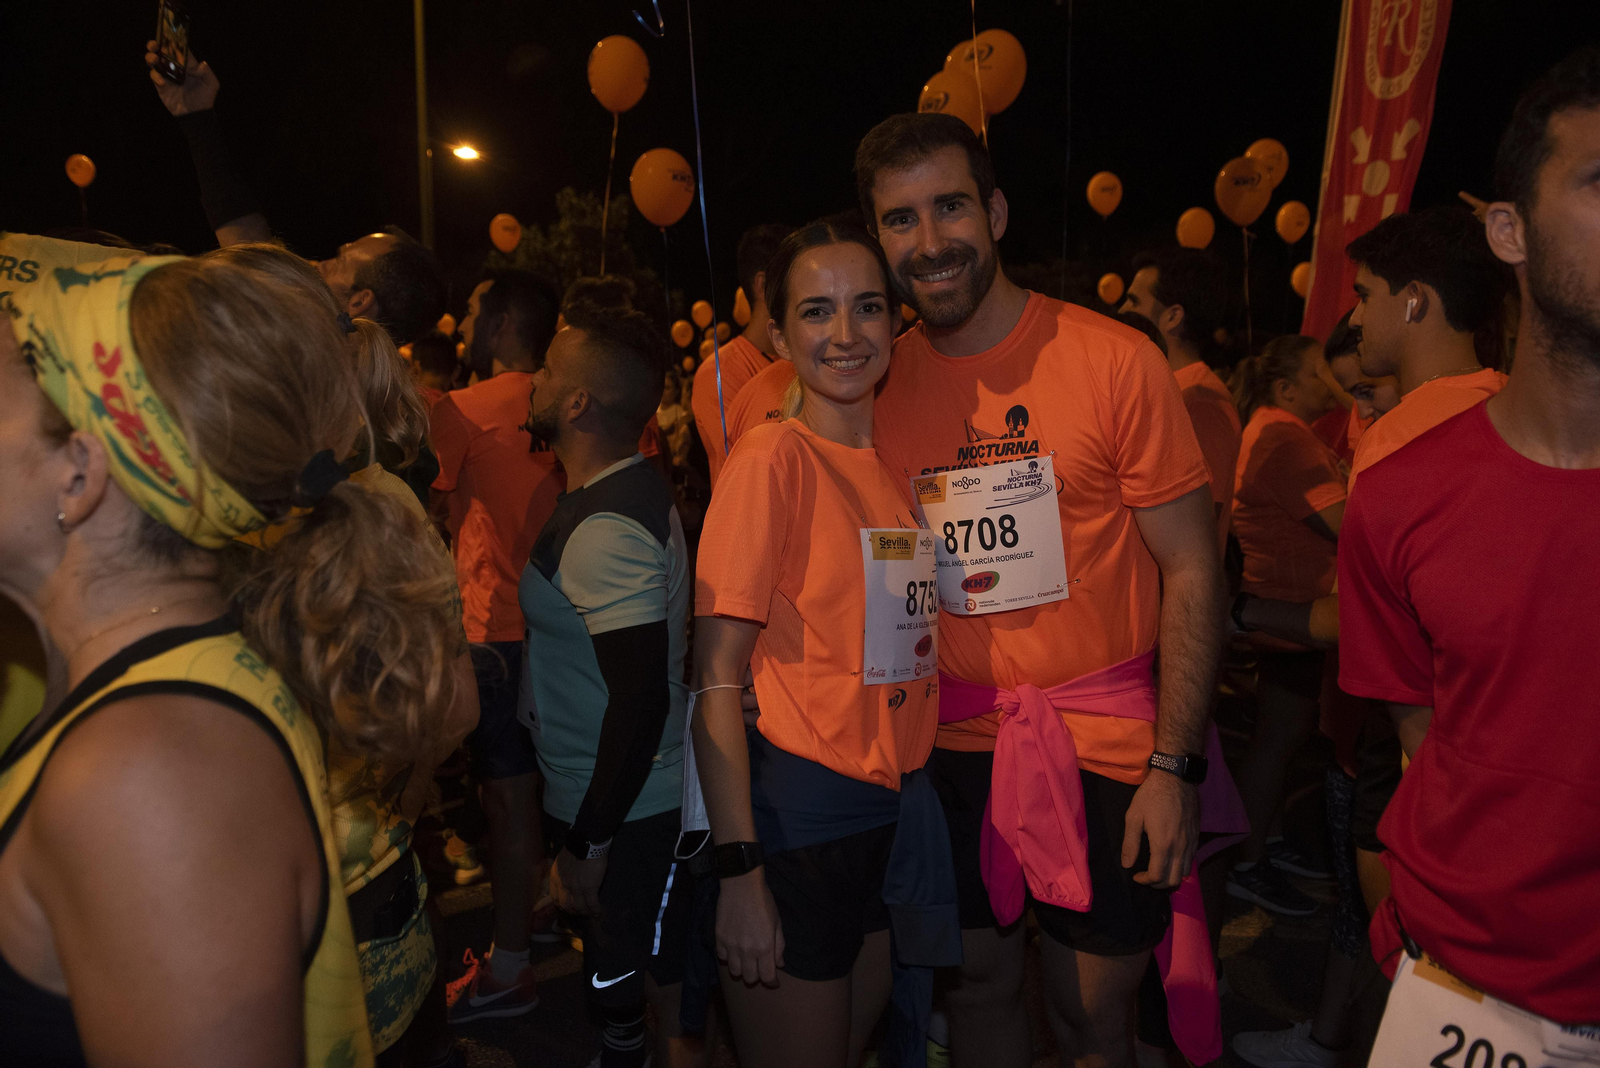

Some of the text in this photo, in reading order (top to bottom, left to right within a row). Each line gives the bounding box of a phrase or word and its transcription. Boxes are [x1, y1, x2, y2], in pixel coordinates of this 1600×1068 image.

[957, 440, 1040, 461] NOCTURNA
[1007, 472, 1043, 483] NOCTURNA
[992, 482, 1024, 493] SEVILLA
[943, 513, 1020, 555] 8708
[969, 554, 994, 566] GARCÍA
[995, 550, 1034, 564] RODRÍGUEZ
[896, 623, 907, 631] ANA
